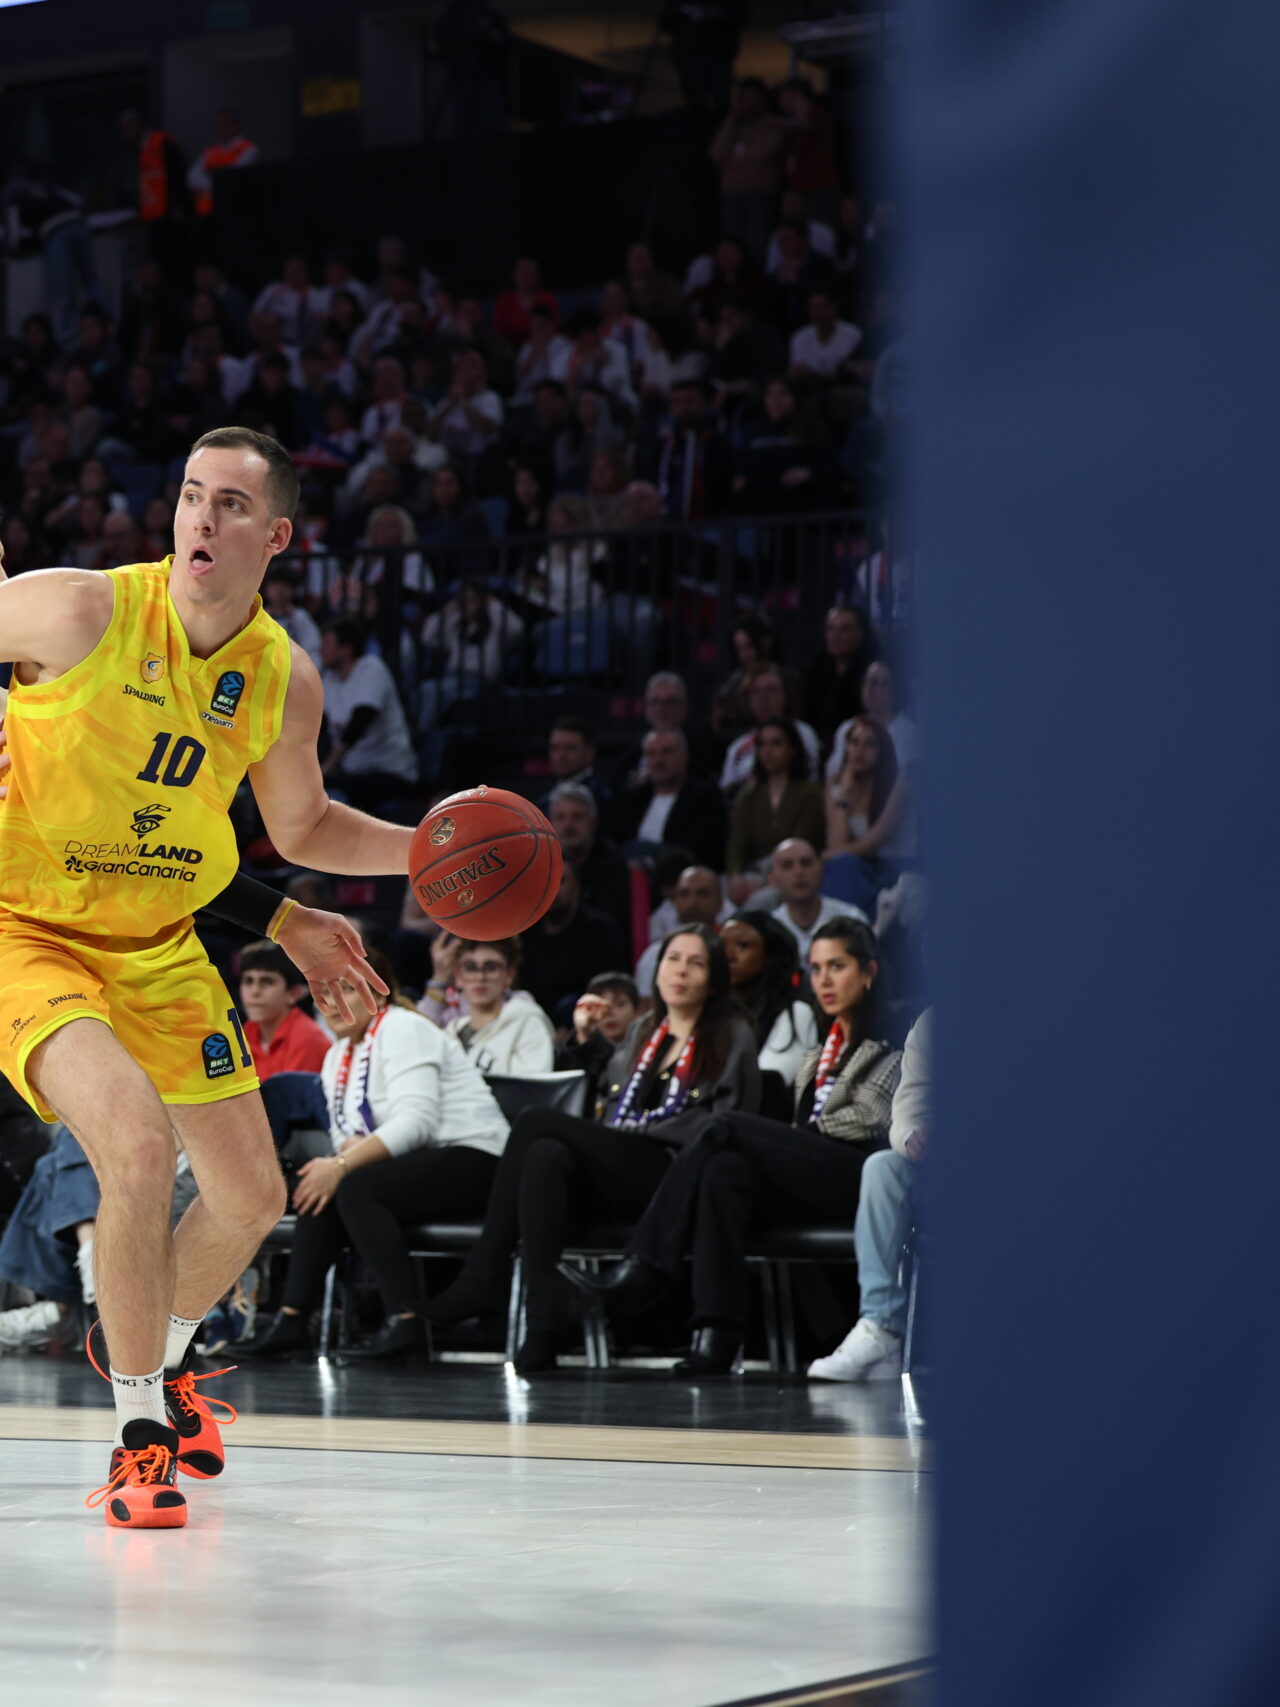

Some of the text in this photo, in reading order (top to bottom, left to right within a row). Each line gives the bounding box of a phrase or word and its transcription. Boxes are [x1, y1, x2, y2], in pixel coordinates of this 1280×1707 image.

[122, 684, 166, 707] SPALDING
[216, 694, 235, 706] BKT
[212, 701, 234, 715] EuroCup
[136, 731, 206, 788] 10
[64, 840, 203, 864] DREAMLAND
[83, 860, 197, 883] GranCanaria
[418, 847, 506, 906] SPALDING
[208, 1065, 233, 1076] EuroCup
[210, 1058, 229, 1068] BKT
